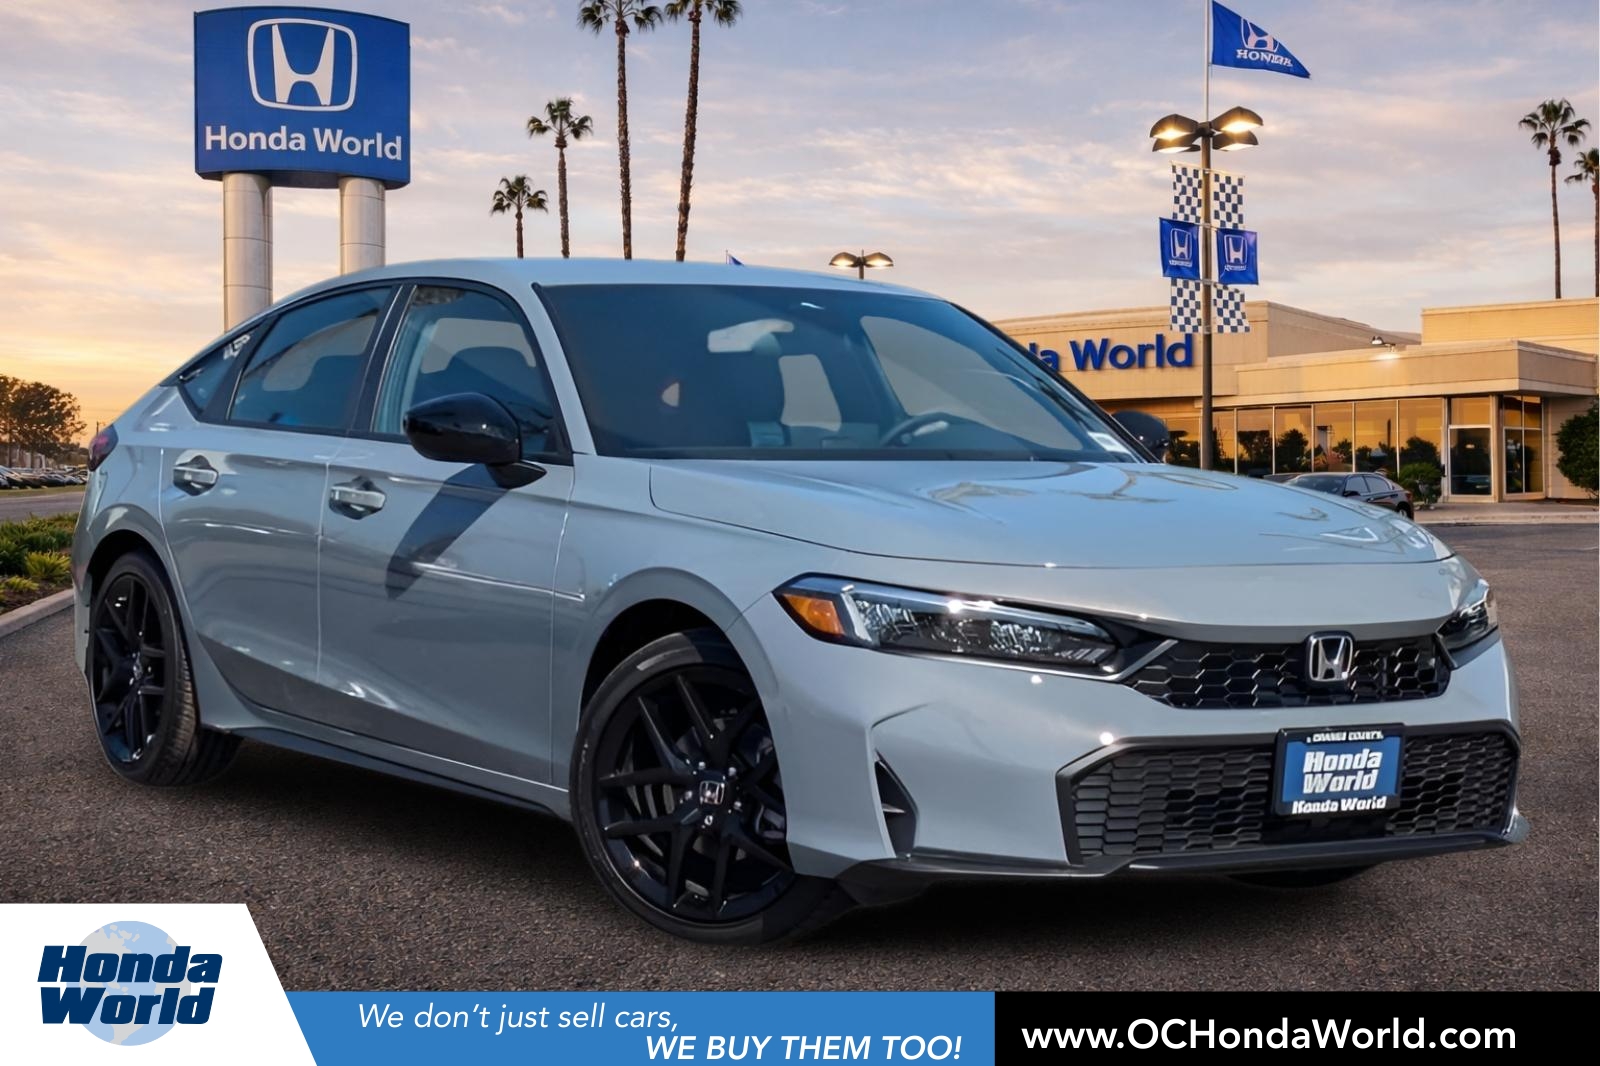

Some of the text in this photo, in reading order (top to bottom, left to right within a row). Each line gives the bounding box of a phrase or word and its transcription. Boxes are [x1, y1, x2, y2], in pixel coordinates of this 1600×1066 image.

[205, 125, 402, 161] Honda World
[1069, 333, 1193, 372] World
[1303, 748, 1383, 773] Honda
[1303, 768, 1379, 794] World
[1292, 796, 1387, 814] Honda World
